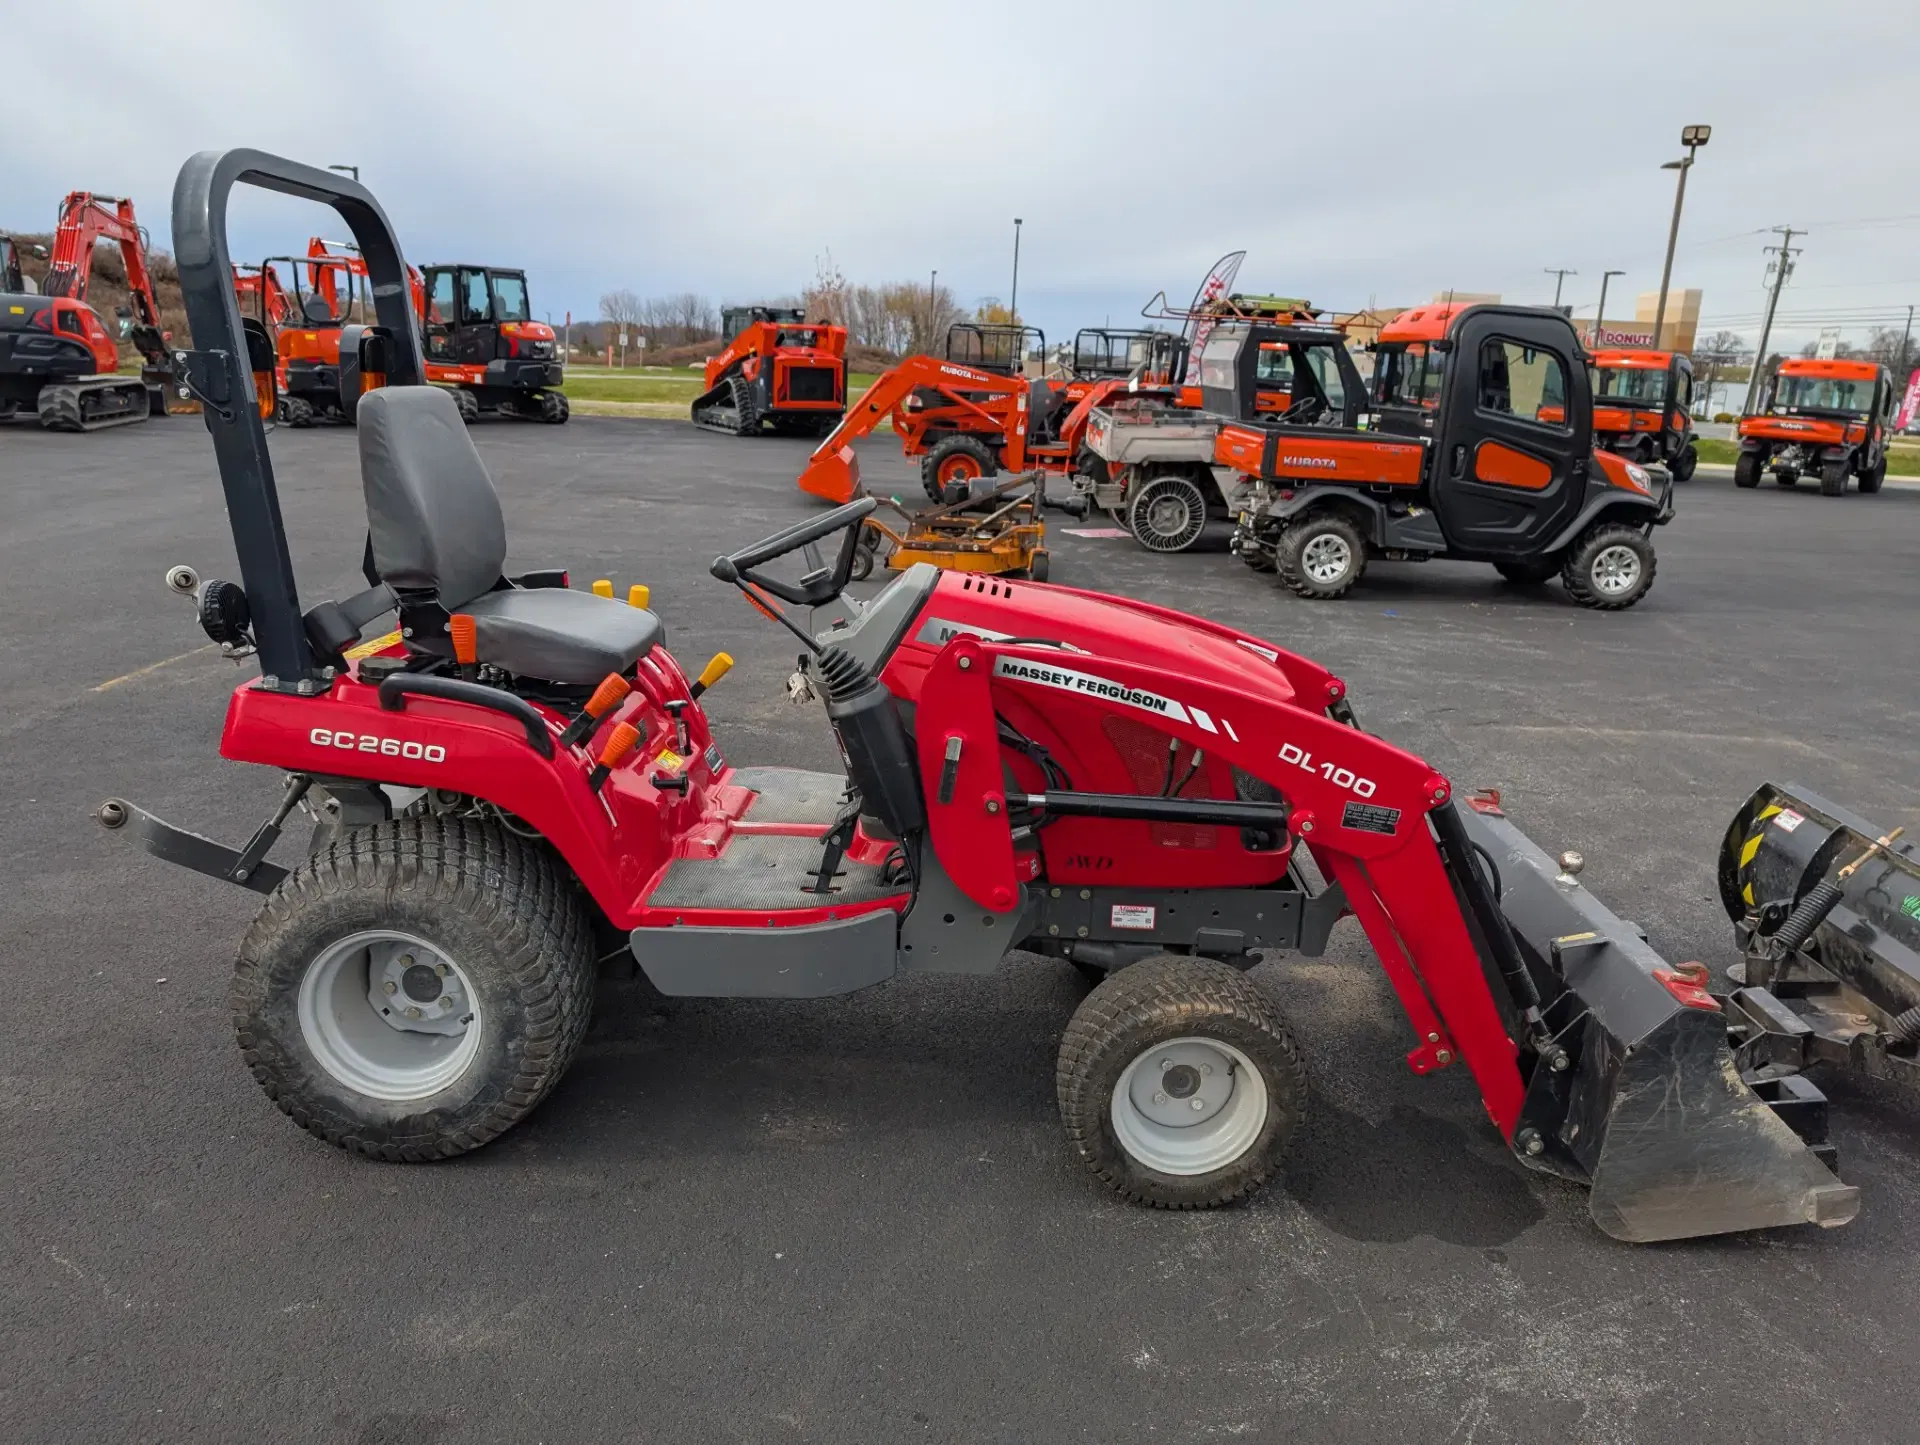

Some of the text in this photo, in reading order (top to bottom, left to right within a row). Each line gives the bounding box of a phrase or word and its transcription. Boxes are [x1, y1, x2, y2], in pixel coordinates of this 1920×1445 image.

[940, 365, 972, 379] KUBOTA
[1283, 456, 1338, 470] KUBOTA
[1002, 663, 1168, 712] MASSEY FERGUSON
[310, 728, 446, 763] GC2600
[1278, 742, 1377, 798] DL100
